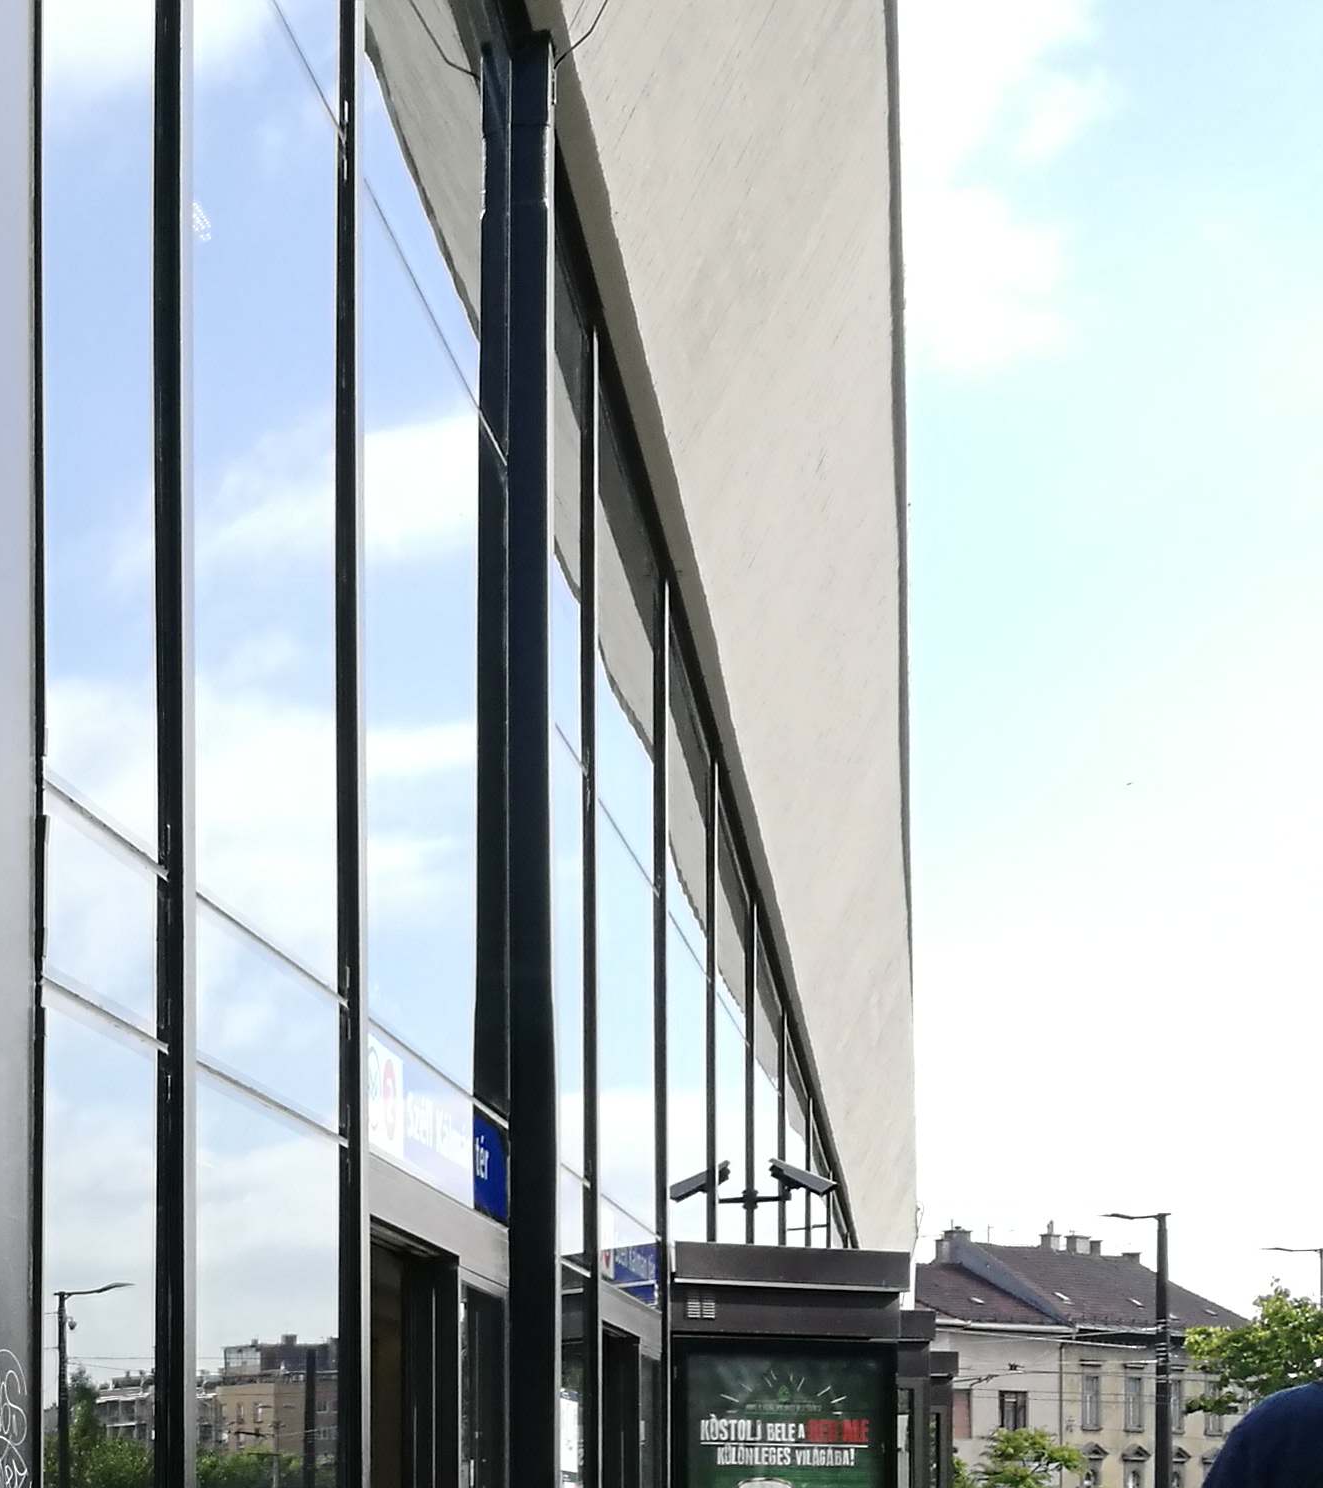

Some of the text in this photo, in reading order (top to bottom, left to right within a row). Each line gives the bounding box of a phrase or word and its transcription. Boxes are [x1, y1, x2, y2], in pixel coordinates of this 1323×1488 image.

[406, 1091, 434, 1148] Széll
[475, 1135, 490, 1180] tér
[700, 1414, 869, 1442] KÓSTOLJ BELE A RED ALE
[717, 1444, 855, 1466] KÜLÖNLEGES VILÁGÁBA!
